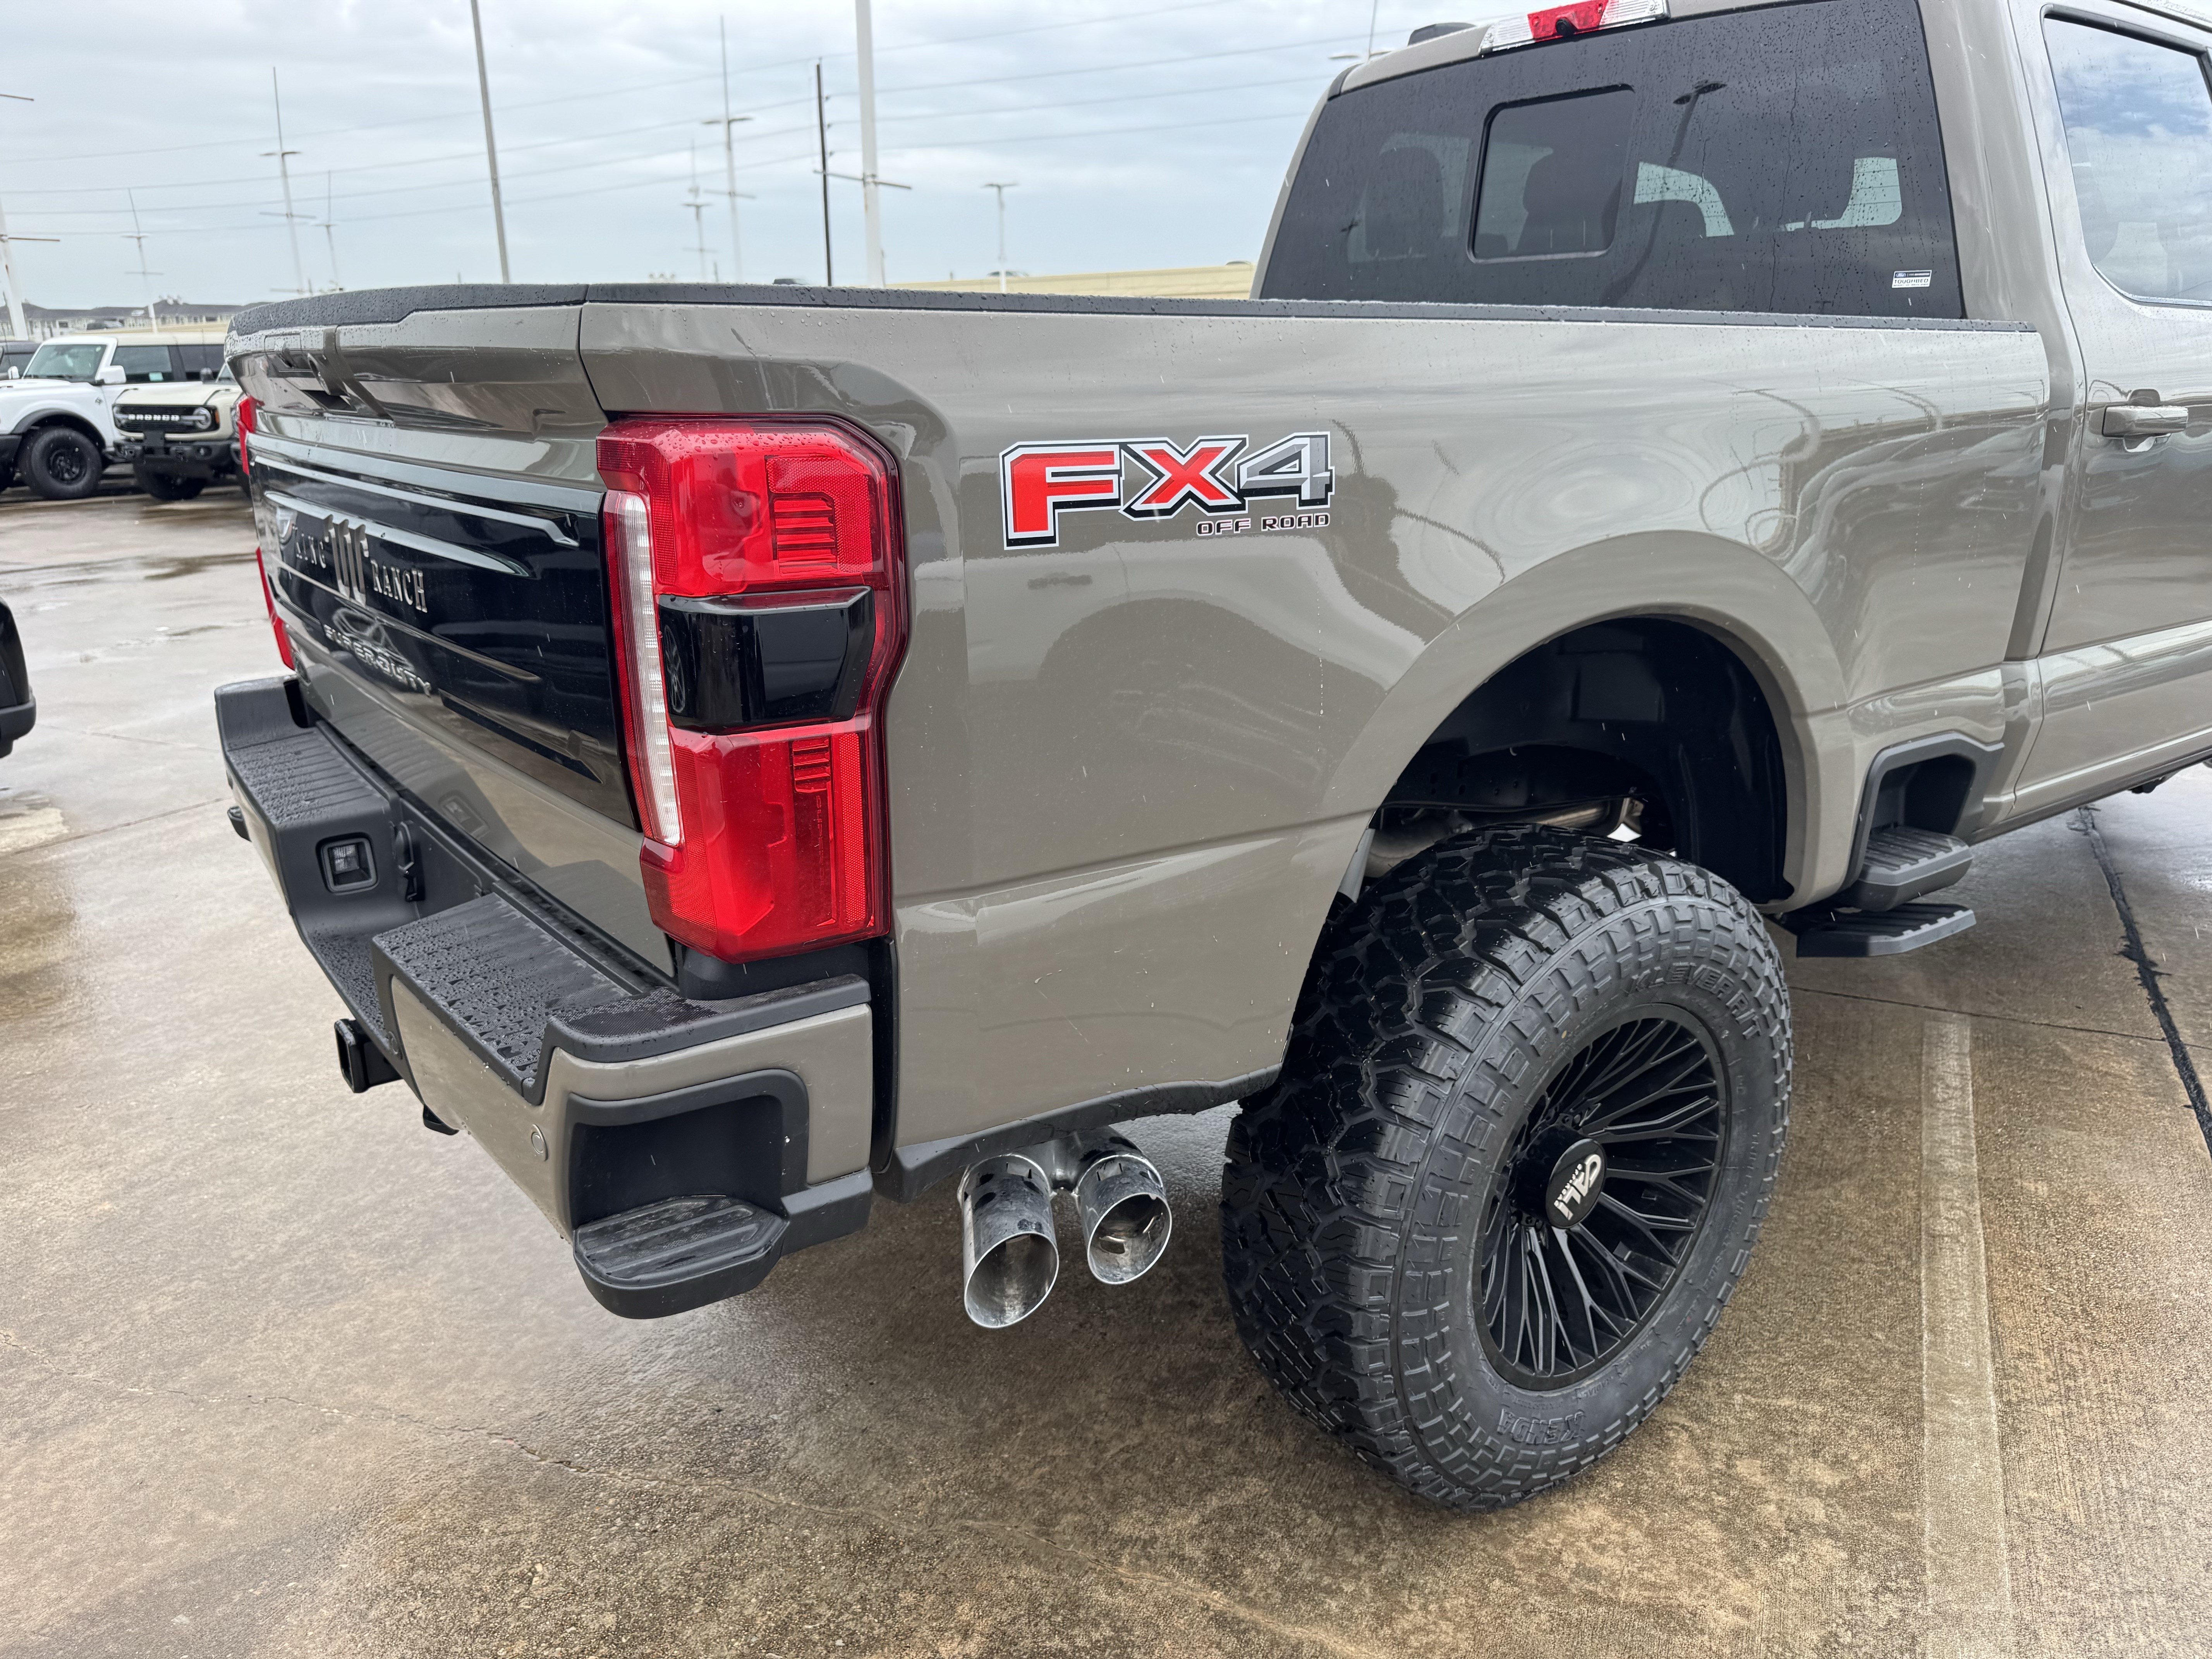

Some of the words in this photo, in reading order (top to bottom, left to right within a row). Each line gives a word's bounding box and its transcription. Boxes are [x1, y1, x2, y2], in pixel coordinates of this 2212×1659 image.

[999, 431, 1335, 550] FX4
[1196, 518, 1251, 536] OFF
[1261, 512, 1330, 531] ROAD
[370, 560, 428, 613] RANCH
[1556, 1154, 1601, 1220] CALI
[1497, 1408, 1585, 1444] KENDA
